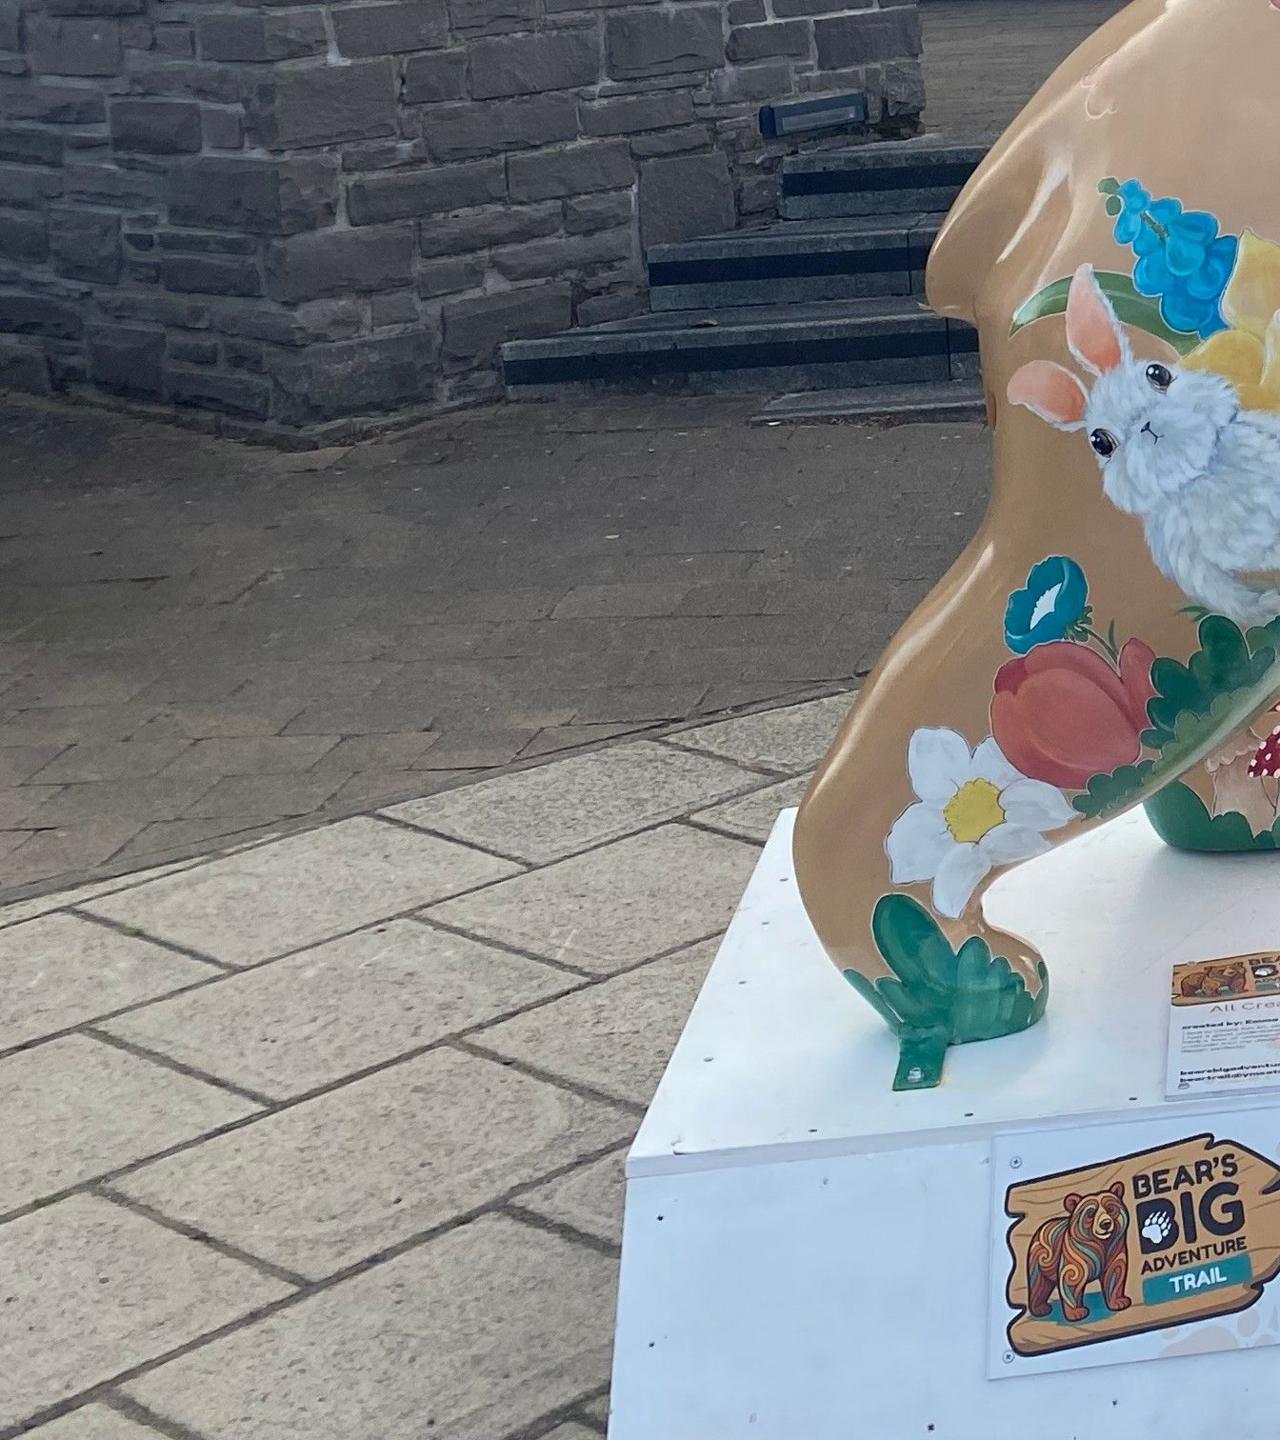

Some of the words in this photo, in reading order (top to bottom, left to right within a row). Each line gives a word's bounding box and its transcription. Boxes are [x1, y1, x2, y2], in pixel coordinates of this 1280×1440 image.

[1210, 1003, 1235, 1013] All
[1132, 1153, 1238, 1199] BEAR'S
[1136, 1182, 1245, 1254] BIG
[1140, 1236, 1247, 1275] ADVENTURE
[1169, 1267, 1227, 1293] TRAIL
